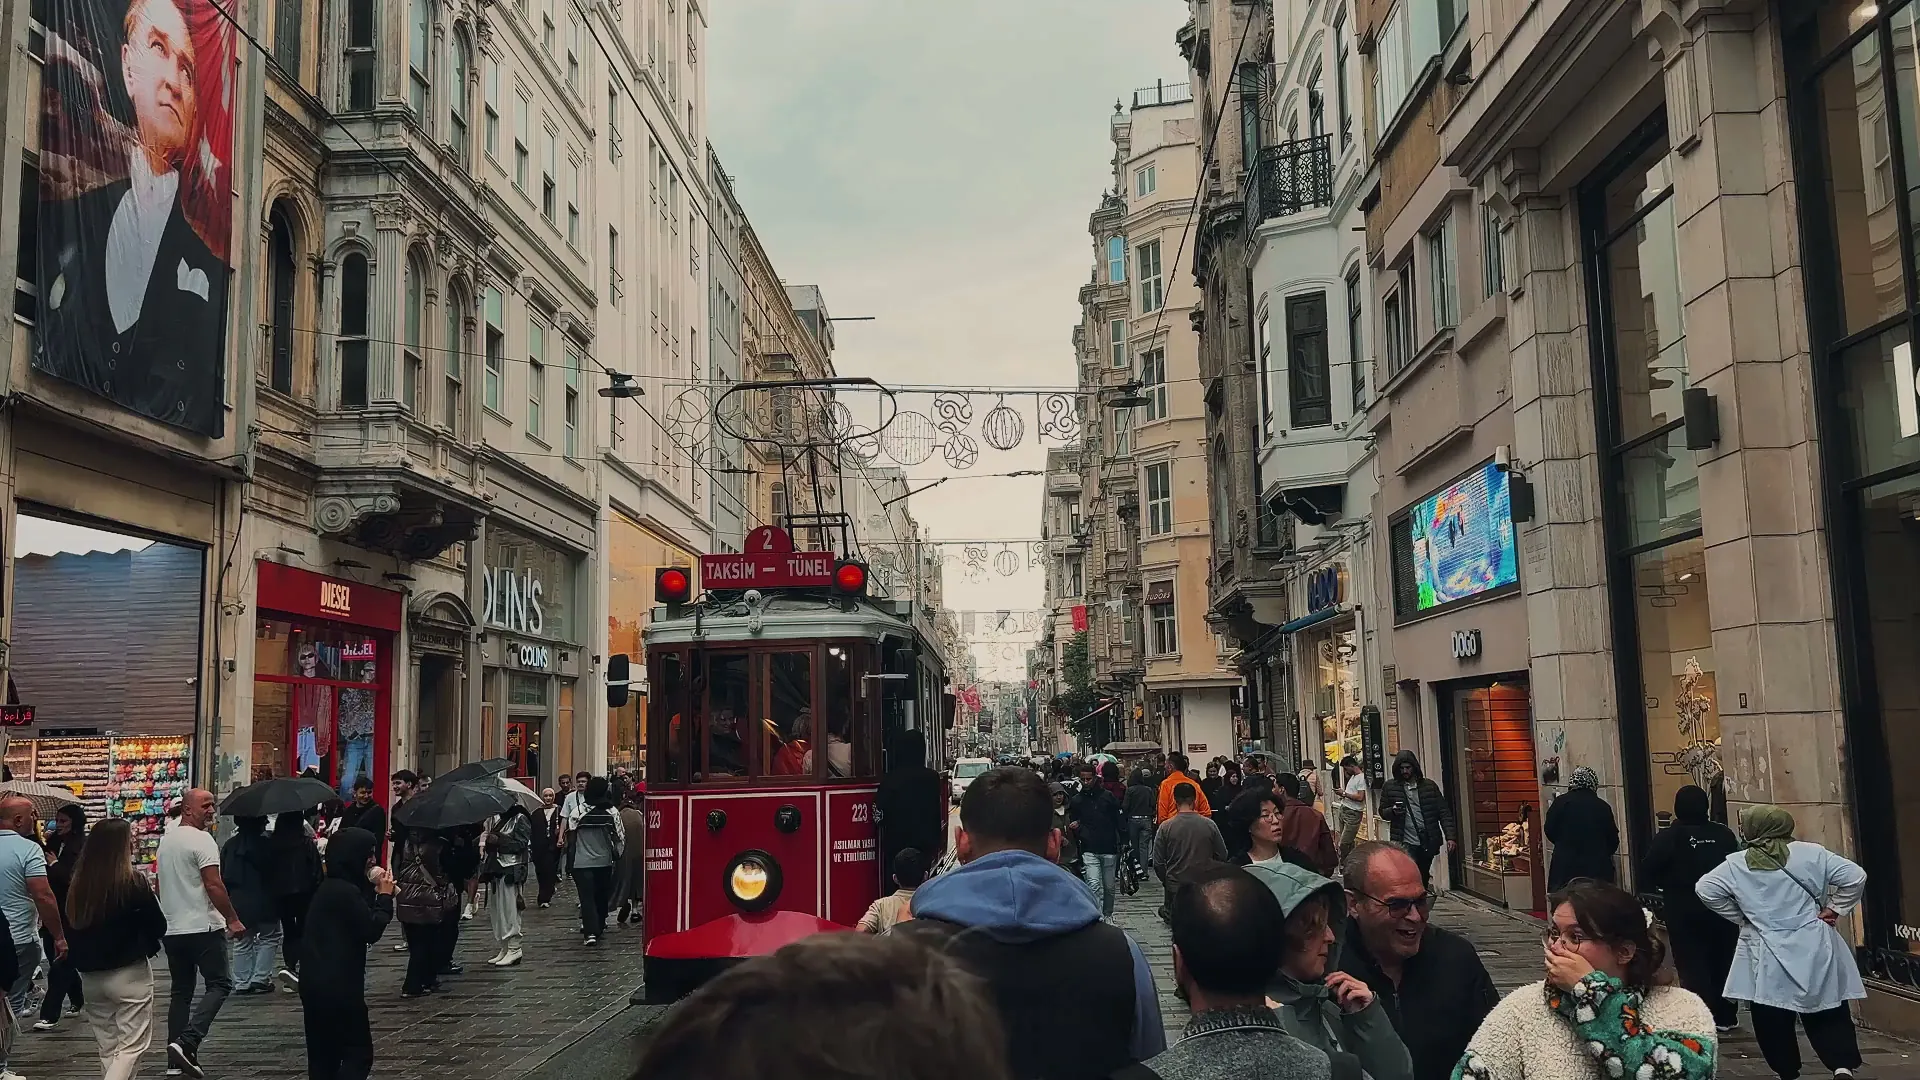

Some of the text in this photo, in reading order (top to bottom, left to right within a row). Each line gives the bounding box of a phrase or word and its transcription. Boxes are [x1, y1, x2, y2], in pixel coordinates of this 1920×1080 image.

[763, 529, 772, 550] 2
[706, 558, 755, 580] TAKSİM
[787, 555, 831, 577] TÜNEL
[320, 581, 350, 611] DIESEL
[1451, 630, 1477, 658] DOGO
[521, 645, 548, 668] COLIN'S
[851, 803, 868, 822] 223
[833, 853, 842, 863] VE
